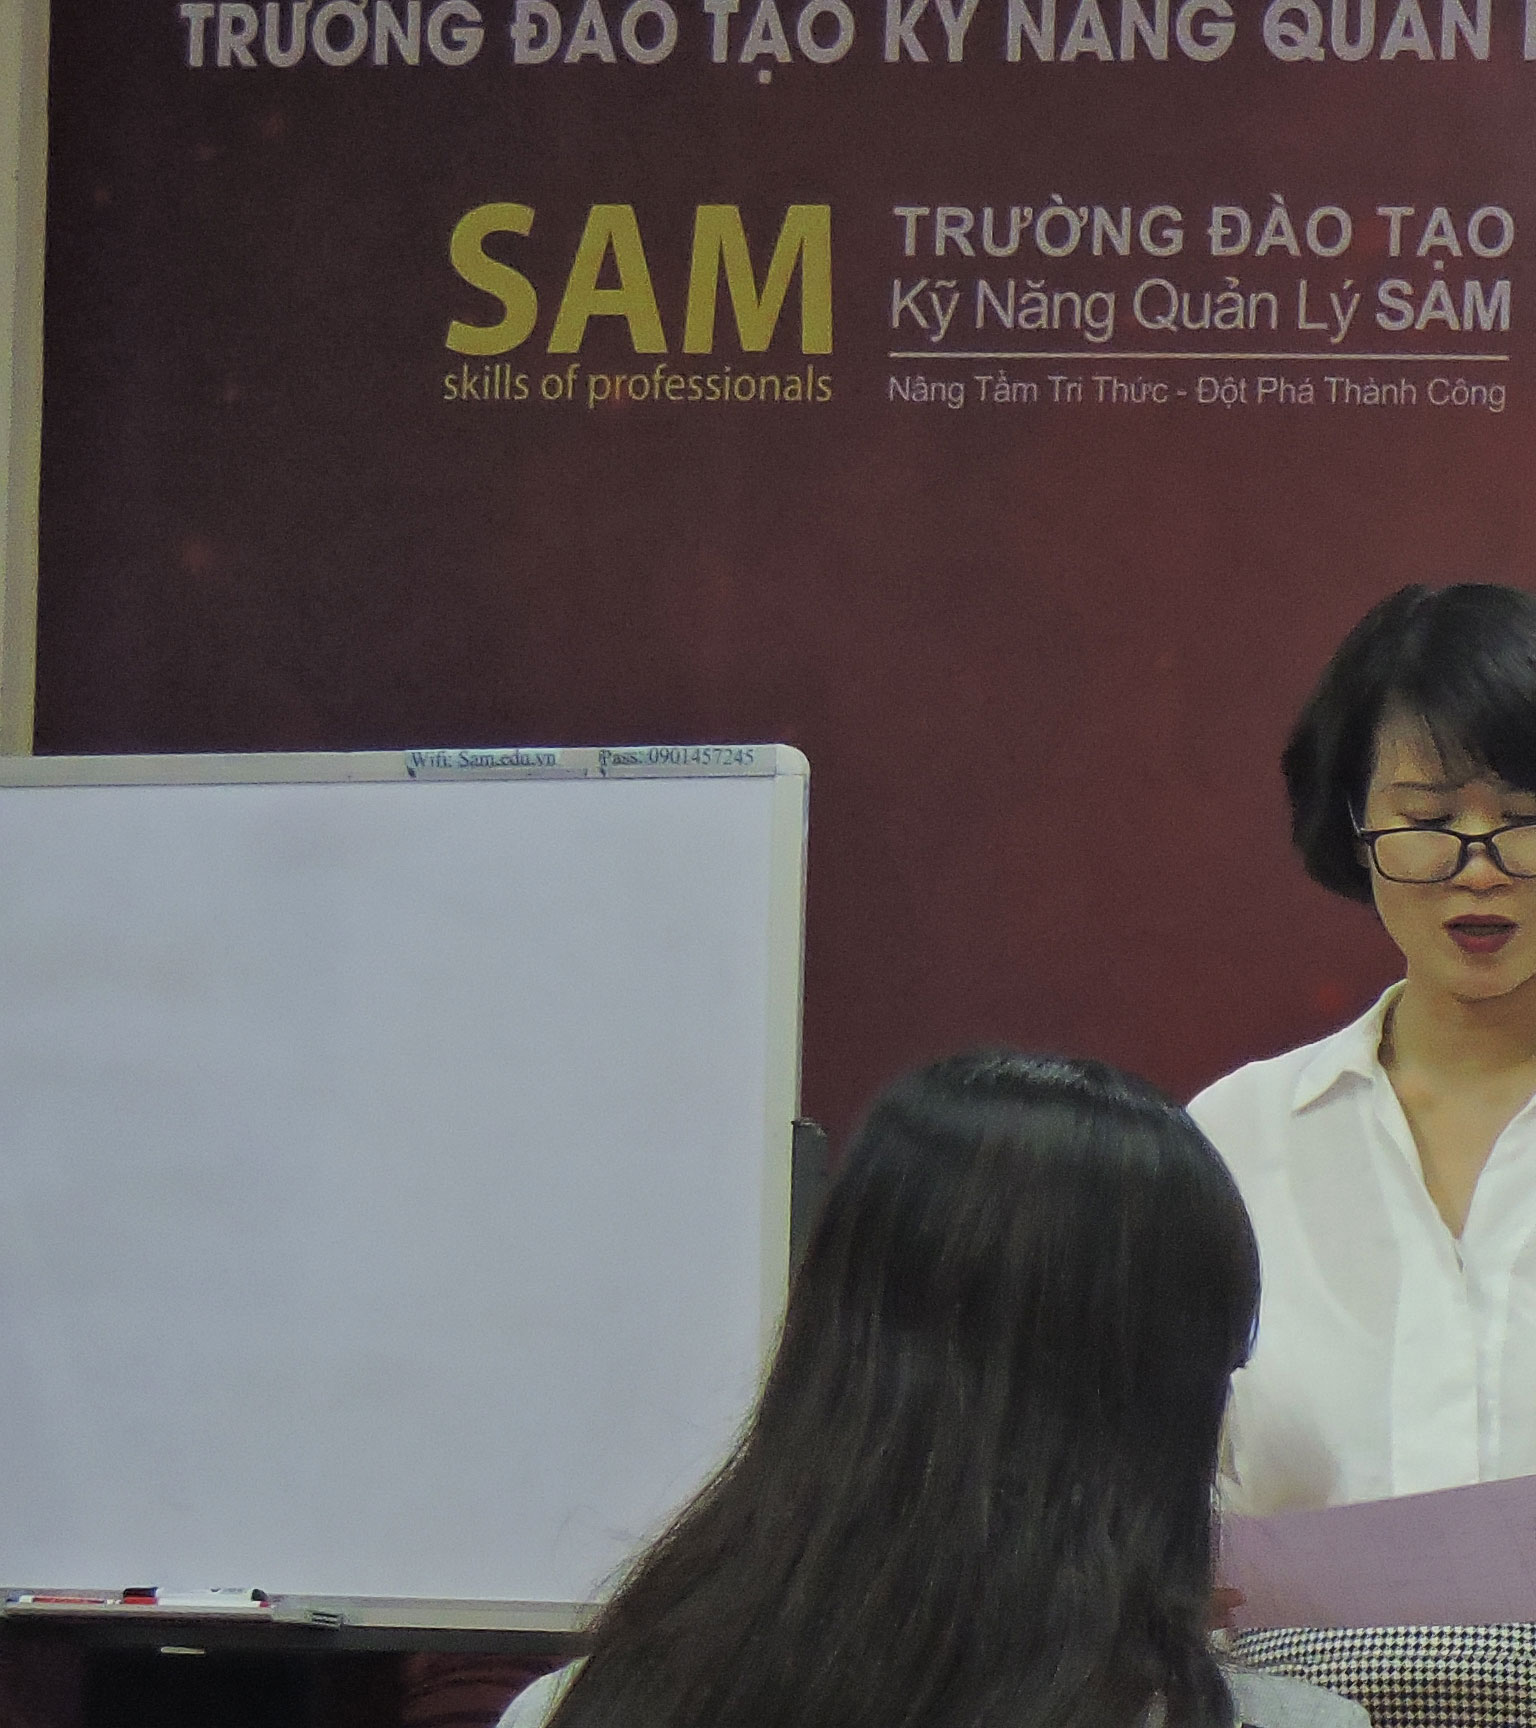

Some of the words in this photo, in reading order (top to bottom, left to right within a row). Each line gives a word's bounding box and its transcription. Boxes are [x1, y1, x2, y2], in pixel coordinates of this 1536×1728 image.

[893, 193, 1184, 257] TRƯỜNG
[1207, 192, 1352, 257] ĐÀO
[1376, 206, 1515, 271] TẠO
[445, 202, 833, 357] SAM
[891, 278, 960, 343] Kỹ
[975, 278, 1115, 343] Năng
[1133, 276, 1278, 333] Quản
[1297, 278, 1361, 344] Lý
[1376, 279, 1511, 331] SAM
[444, 363, 528, 400] skills
[541, 363, 580, 400] of
[588, 364, 832, 409] professionals
[888, 375, 965, 409] Nâng
[974, 369, 1038, 403] Tầm
[1048, 374, 1083, 402] Tri
[1091, 375, 1169, 403] Thức
[1197, 376, 1247, 409] Đột
[1257, 377, 1314, 404] Phá
[1324, 375, 1417, 405] Thành
[1428, 377, 1506, 413] Công
[458, 749, 557, 769] Sam.edu.vn
[649, 746, 755, 767] 0901457245
